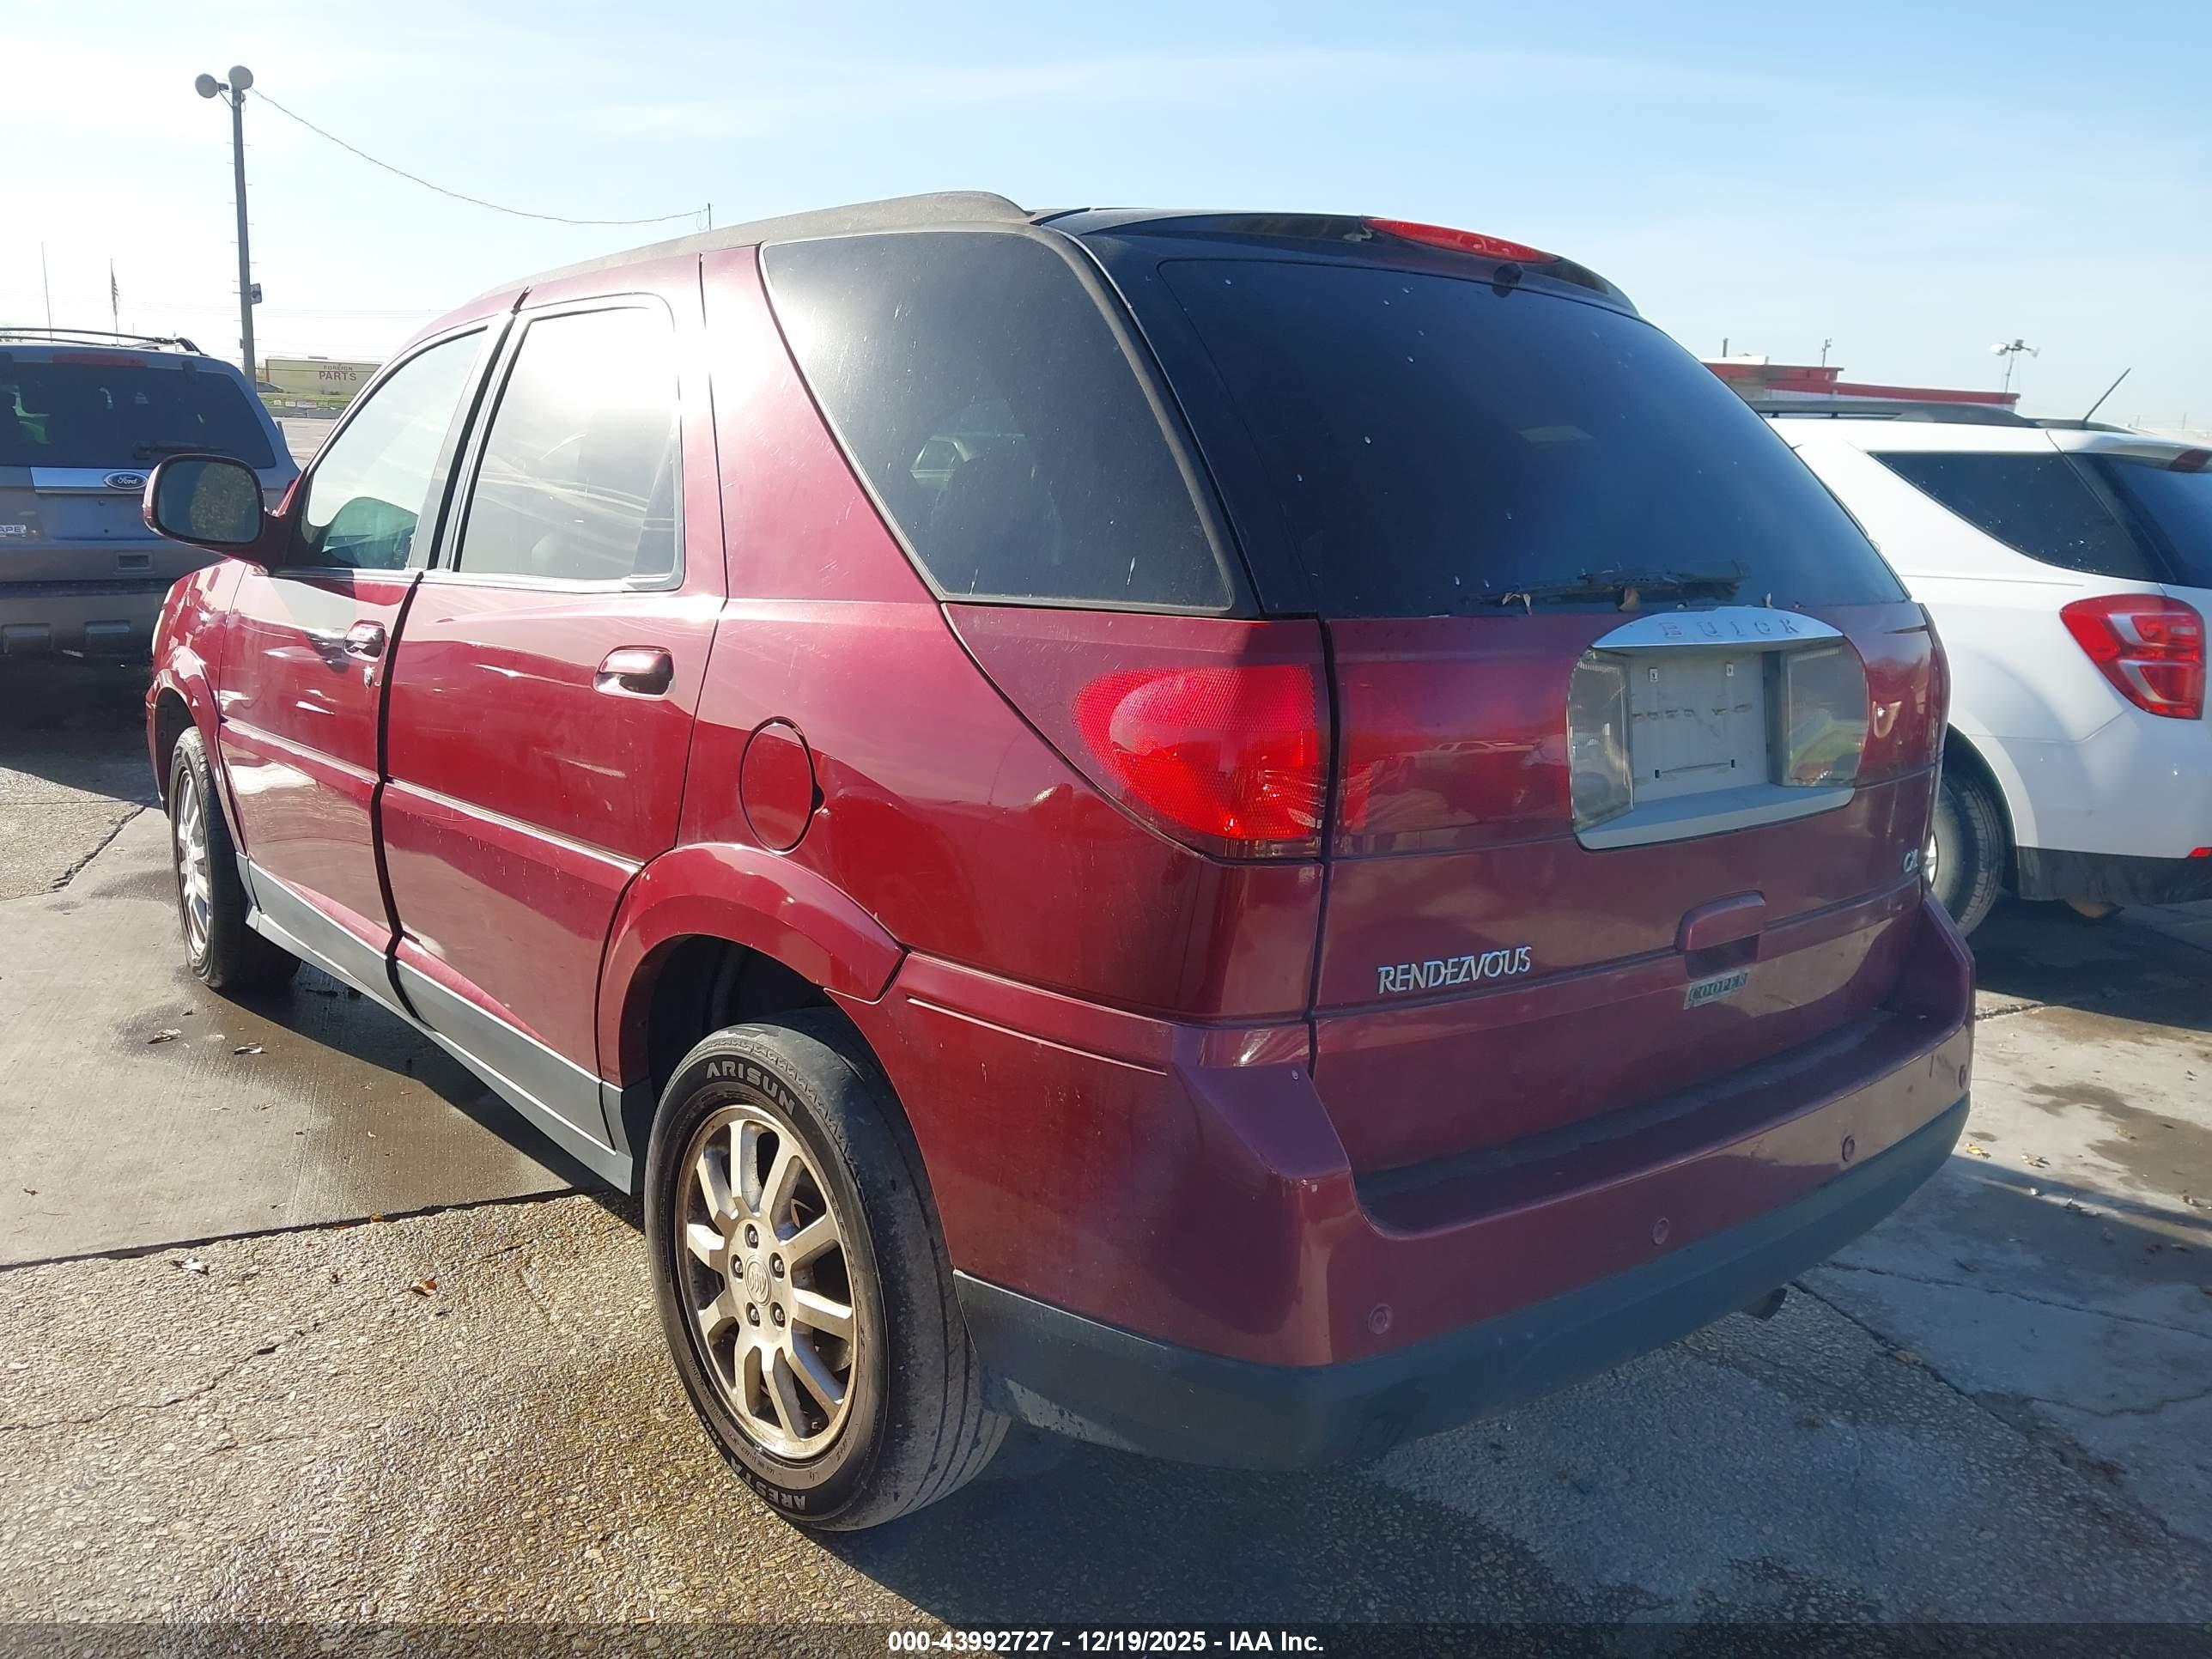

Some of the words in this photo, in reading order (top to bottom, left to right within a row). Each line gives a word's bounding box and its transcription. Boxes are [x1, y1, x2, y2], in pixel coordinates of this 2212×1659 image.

[319, 370, 357, 381] PARTS
[117, 475, 138, 485] Ford
[1658, 617, 1799, 638] BUICK
[1377, 945, 1533, 994] RENDEZVOUS
[706, 1060, 796, 1116] ARISUN
[729, 1455, 806, 1511] ARESTA
